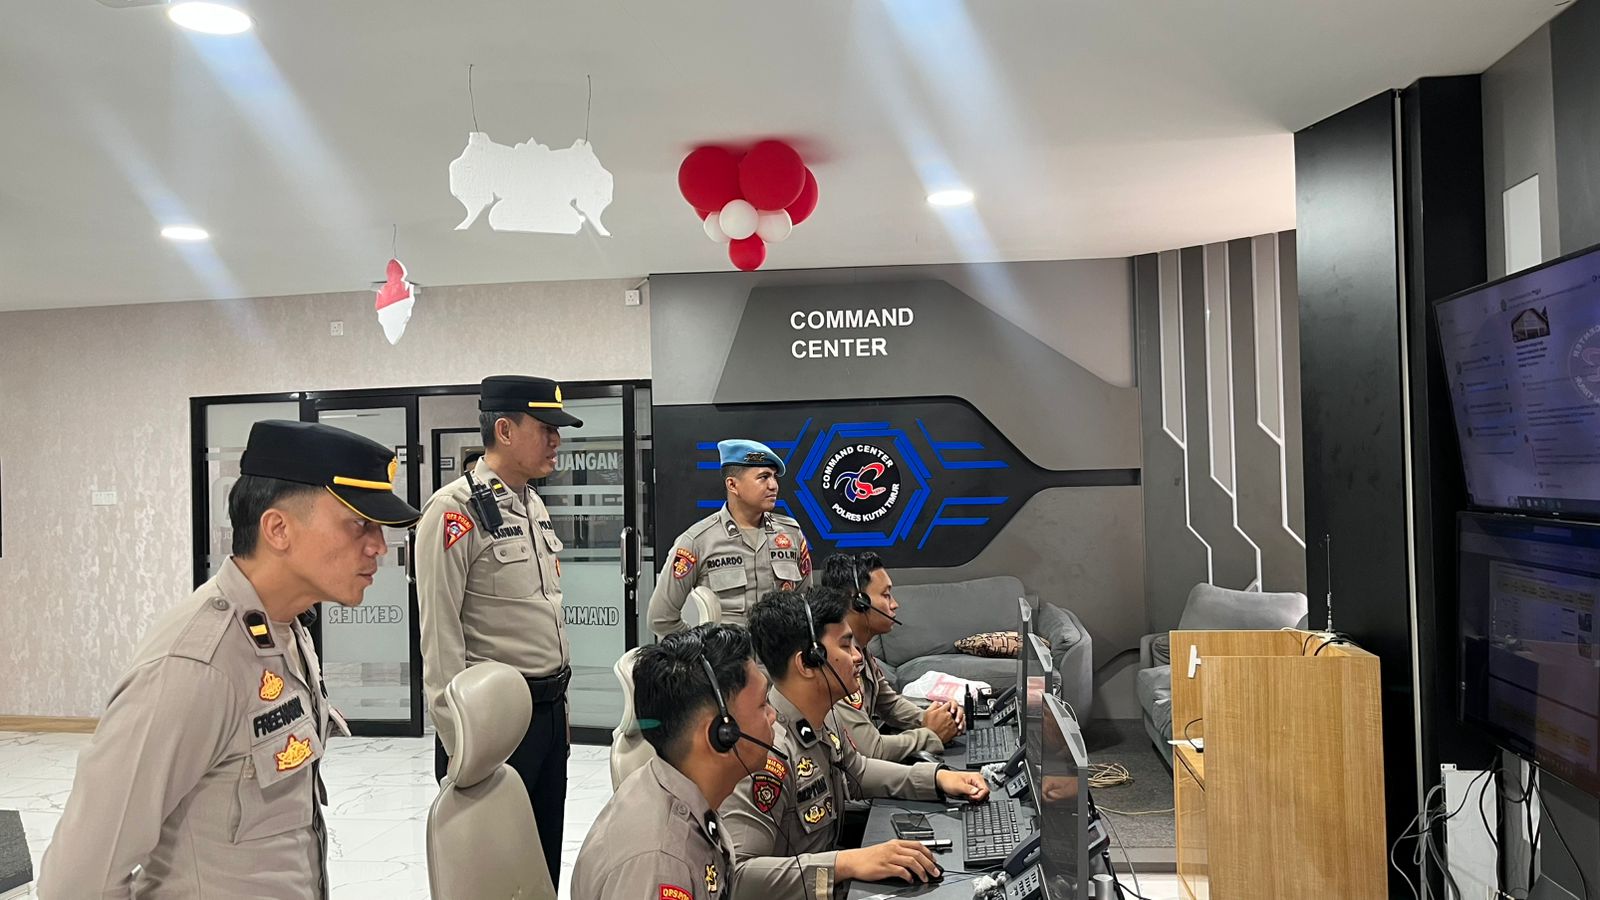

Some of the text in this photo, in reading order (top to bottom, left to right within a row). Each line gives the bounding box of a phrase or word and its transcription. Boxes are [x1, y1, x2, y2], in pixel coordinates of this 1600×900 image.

[790, 307, 915, 330] COMMAND
[791, 337, 888, 359] CENTER
[555, 452, 618, 471] UANGAN
[822, 445, 894, 489] COMMAND CENTER
[832, 483, 900, 522] POLRES KUTAI TIMUR
[707, 556, 743, 569] RICARDO
[770, 551, 797, 561] POLRI
[561, 606, 619, 626] MMAND
